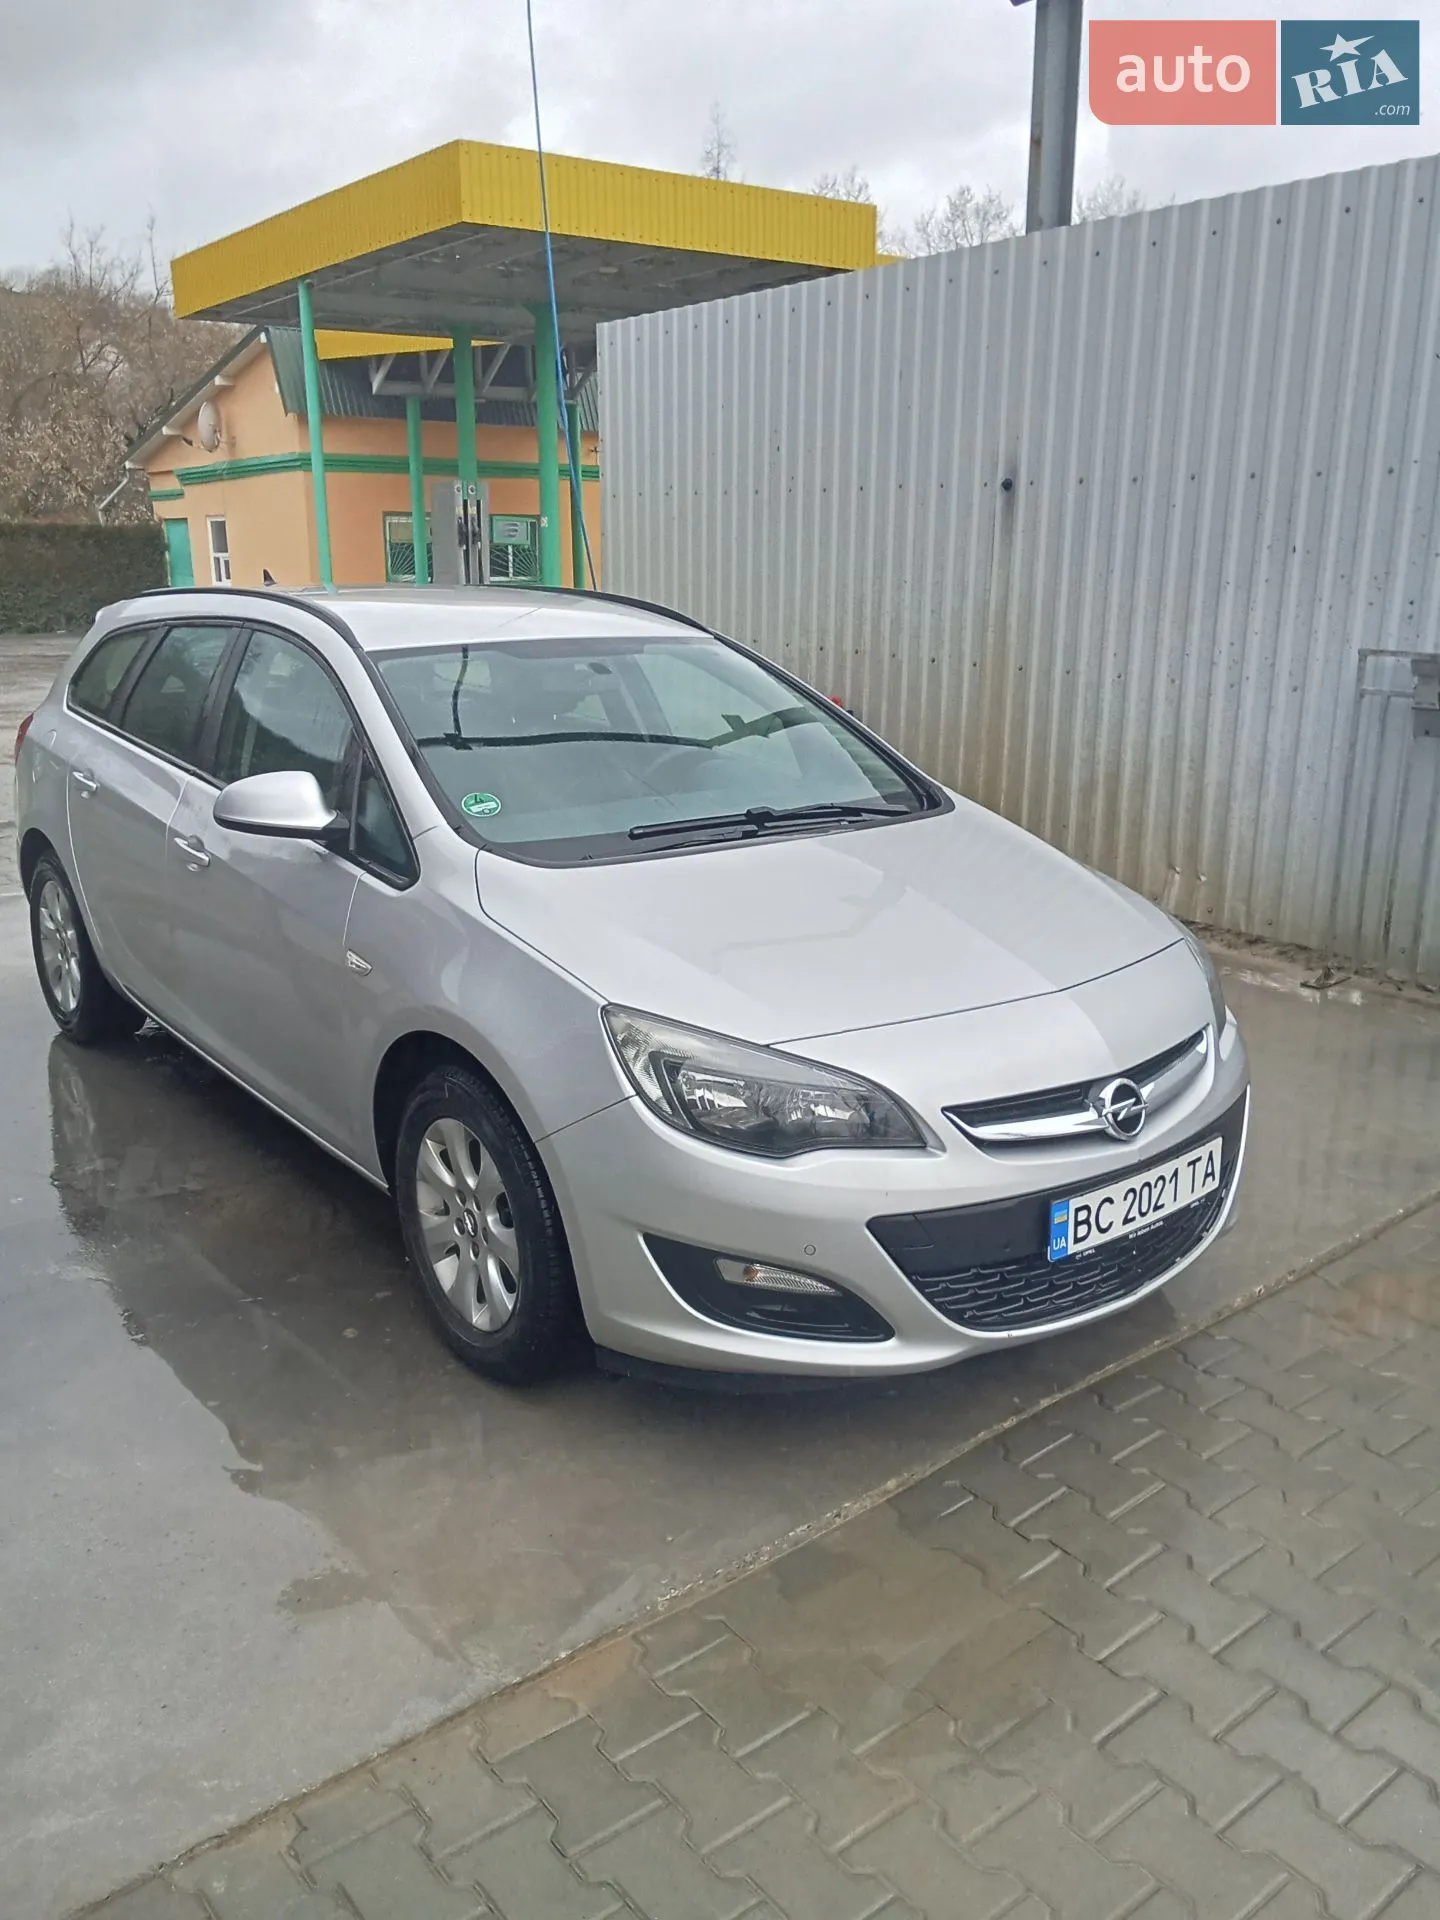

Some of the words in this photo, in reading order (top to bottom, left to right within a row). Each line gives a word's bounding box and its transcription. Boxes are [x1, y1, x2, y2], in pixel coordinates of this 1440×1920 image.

[1073, 1196, 1115, 1246] BC
[1122, 1167, 1180, 1226] 2021
[1187, 1150, 1216, 1194] TA
[1053, 1236, 1068, 1250] UA
